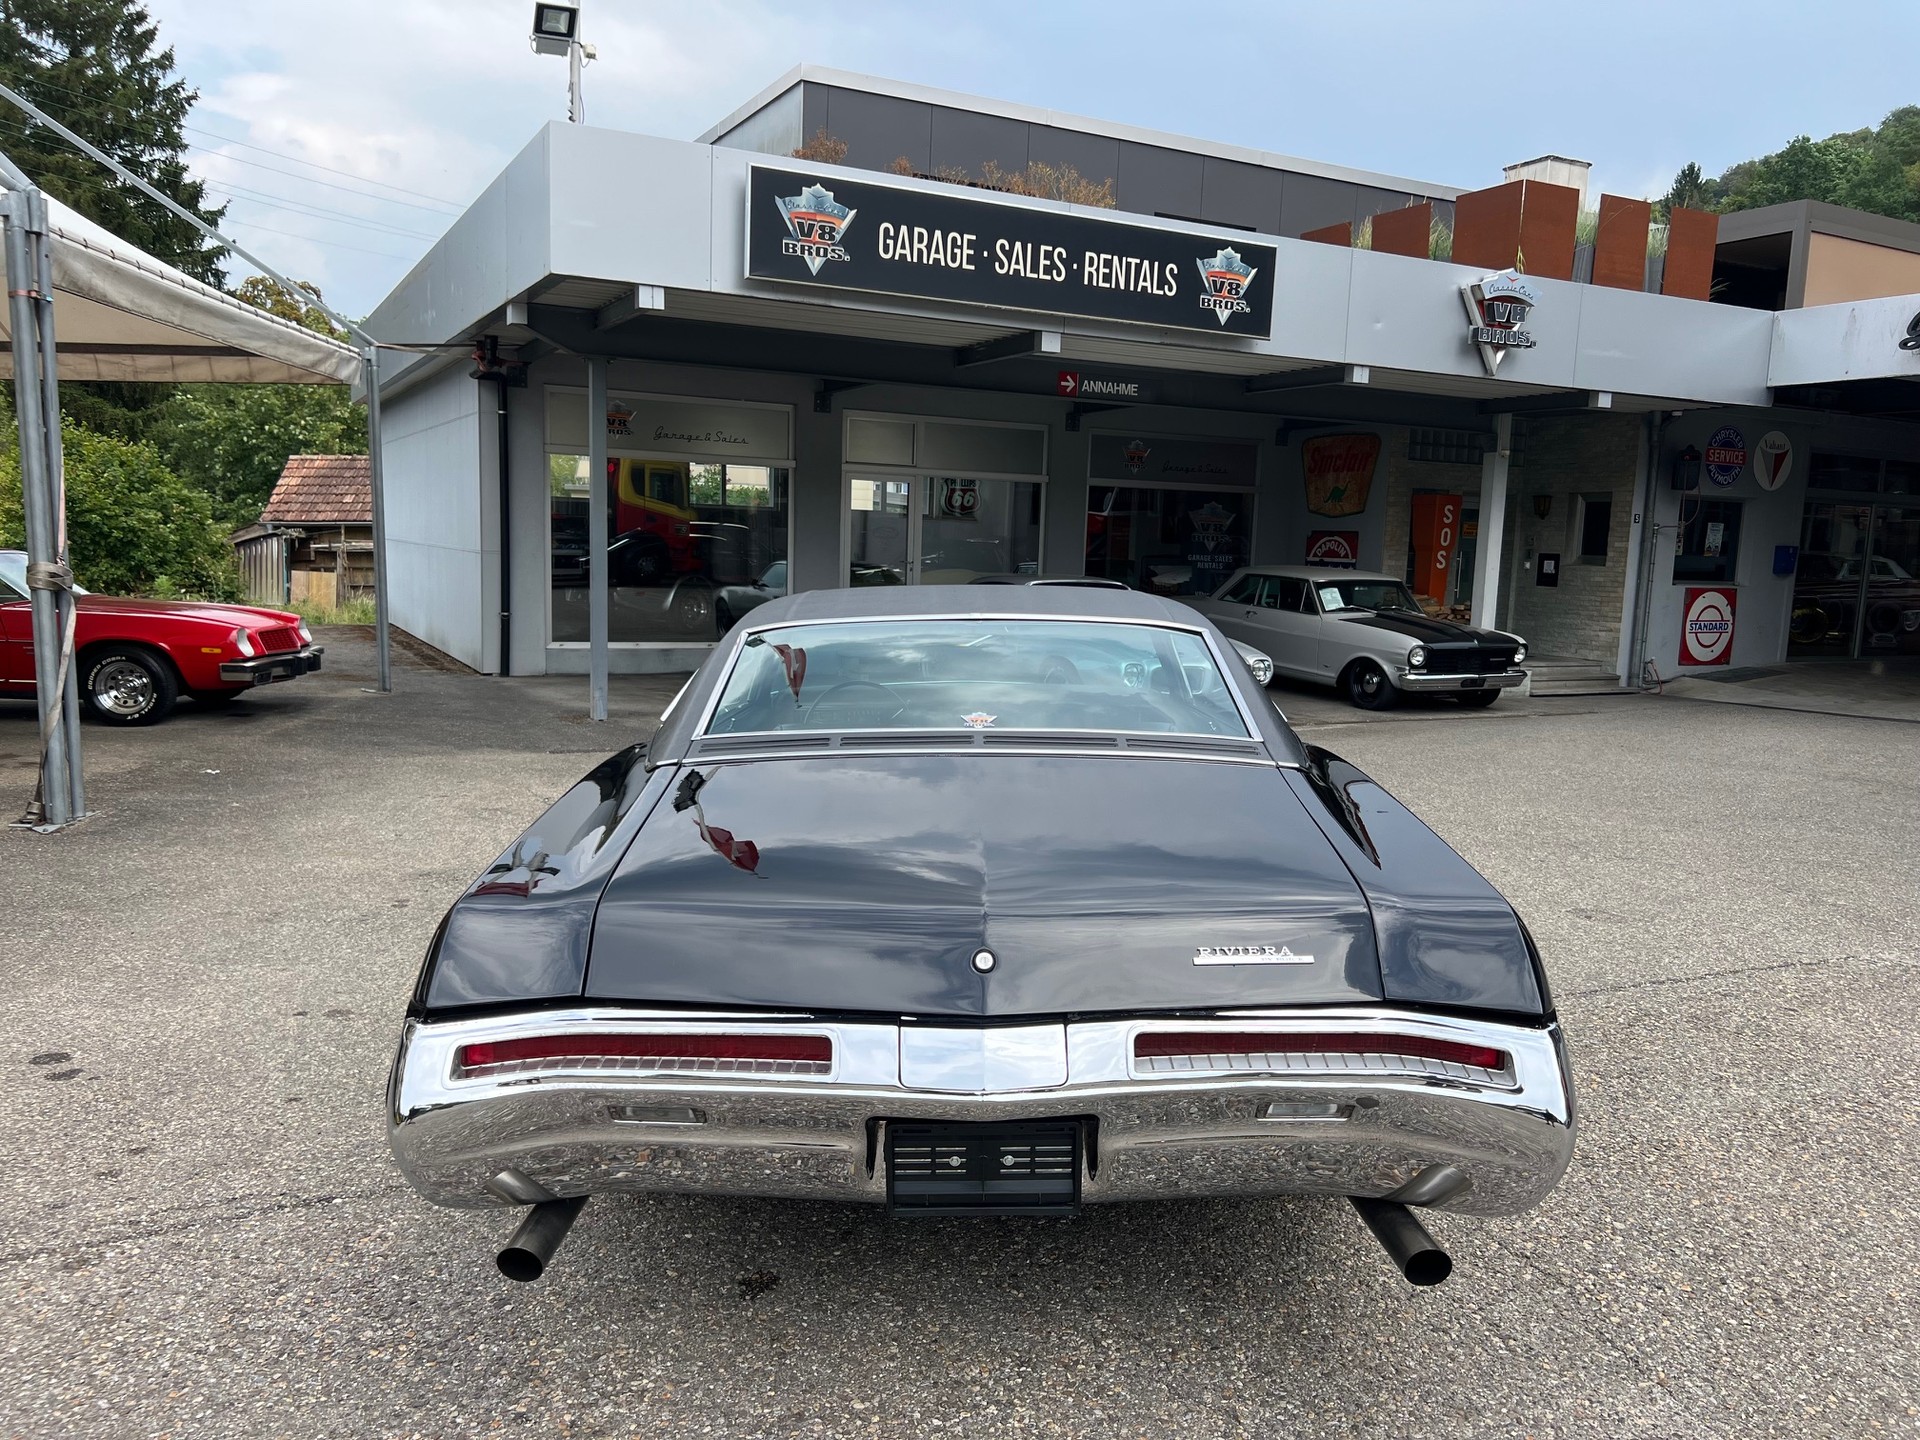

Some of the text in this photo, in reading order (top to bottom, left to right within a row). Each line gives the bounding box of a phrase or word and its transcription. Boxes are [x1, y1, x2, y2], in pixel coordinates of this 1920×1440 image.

[795, 218, 838, 243] V8
[783, 239, 850, 261] BROS.
[878, 221, 1178, 297] GARAGE SALES RENTALS
[1210, 278, 1242, 297] V8
[1488, 284, 1534, 300] Classic Cars
[1200, 294, 1251, 313] BROS.
[1494, 301, 1527, 323] V8
[1478, 326, 1537, 347] BROS.
[1081, 380, 1138, 396] ANNAHME
[607, 418, 628, 427] V8
[608, 428, 632, 436] ROS
[653, 426, 749, 444] Garage & Sales
[1711, 429, 1743, 448] CHRYSLER
[1764, 439, 1786, 450] Valiant
[1308, 445, 1373, 474] Sinclair
[1708, 449, 1744, 464] SERVICE
[1708, 464, 1741, 484] PLYMOUTH
[951, 490, 975, 507] 66
[1436, 504, 1454, 569] SOS
[1315, 541, 1346, 557] DAPOLIN
[1187, 554, 1233, 563] GARAGE SALES
[1197, 562, 1223, 570] RENTALS
[1689, 622, 1729, 631] STANDARD
[101, 656, 126, 665] COBRA
[1197, 946, 1294, 957] RIVIERA
